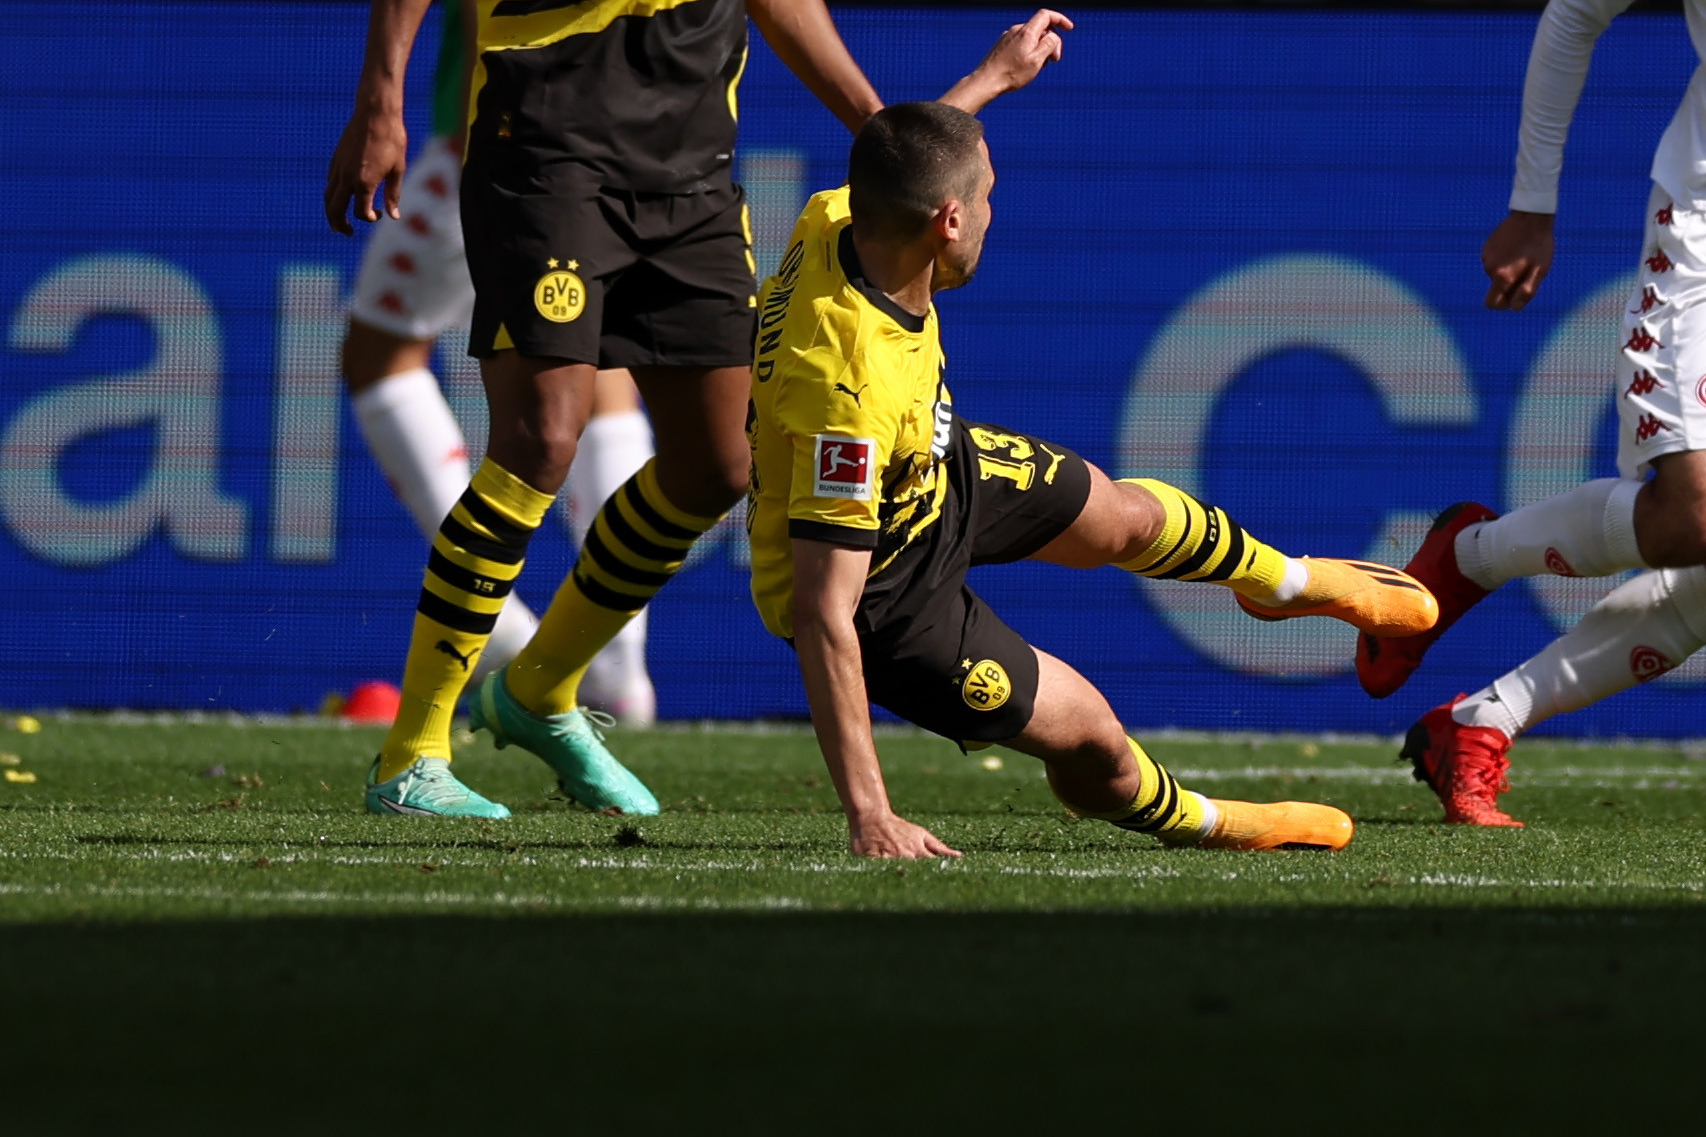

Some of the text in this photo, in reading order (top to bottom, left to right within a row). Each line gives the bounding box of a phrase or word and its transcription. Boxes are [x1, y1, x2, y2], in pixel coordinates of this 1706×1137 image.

[542, 276, 580, 307] BVB
[552, 305, 567, 317] 09
[969, 427, 1036, 492] 13
[818, 484, 867, 494] BUNDESLIGA
[969, 666, 1000, 705] BVB
[992, 686, 1006, 701] 09
